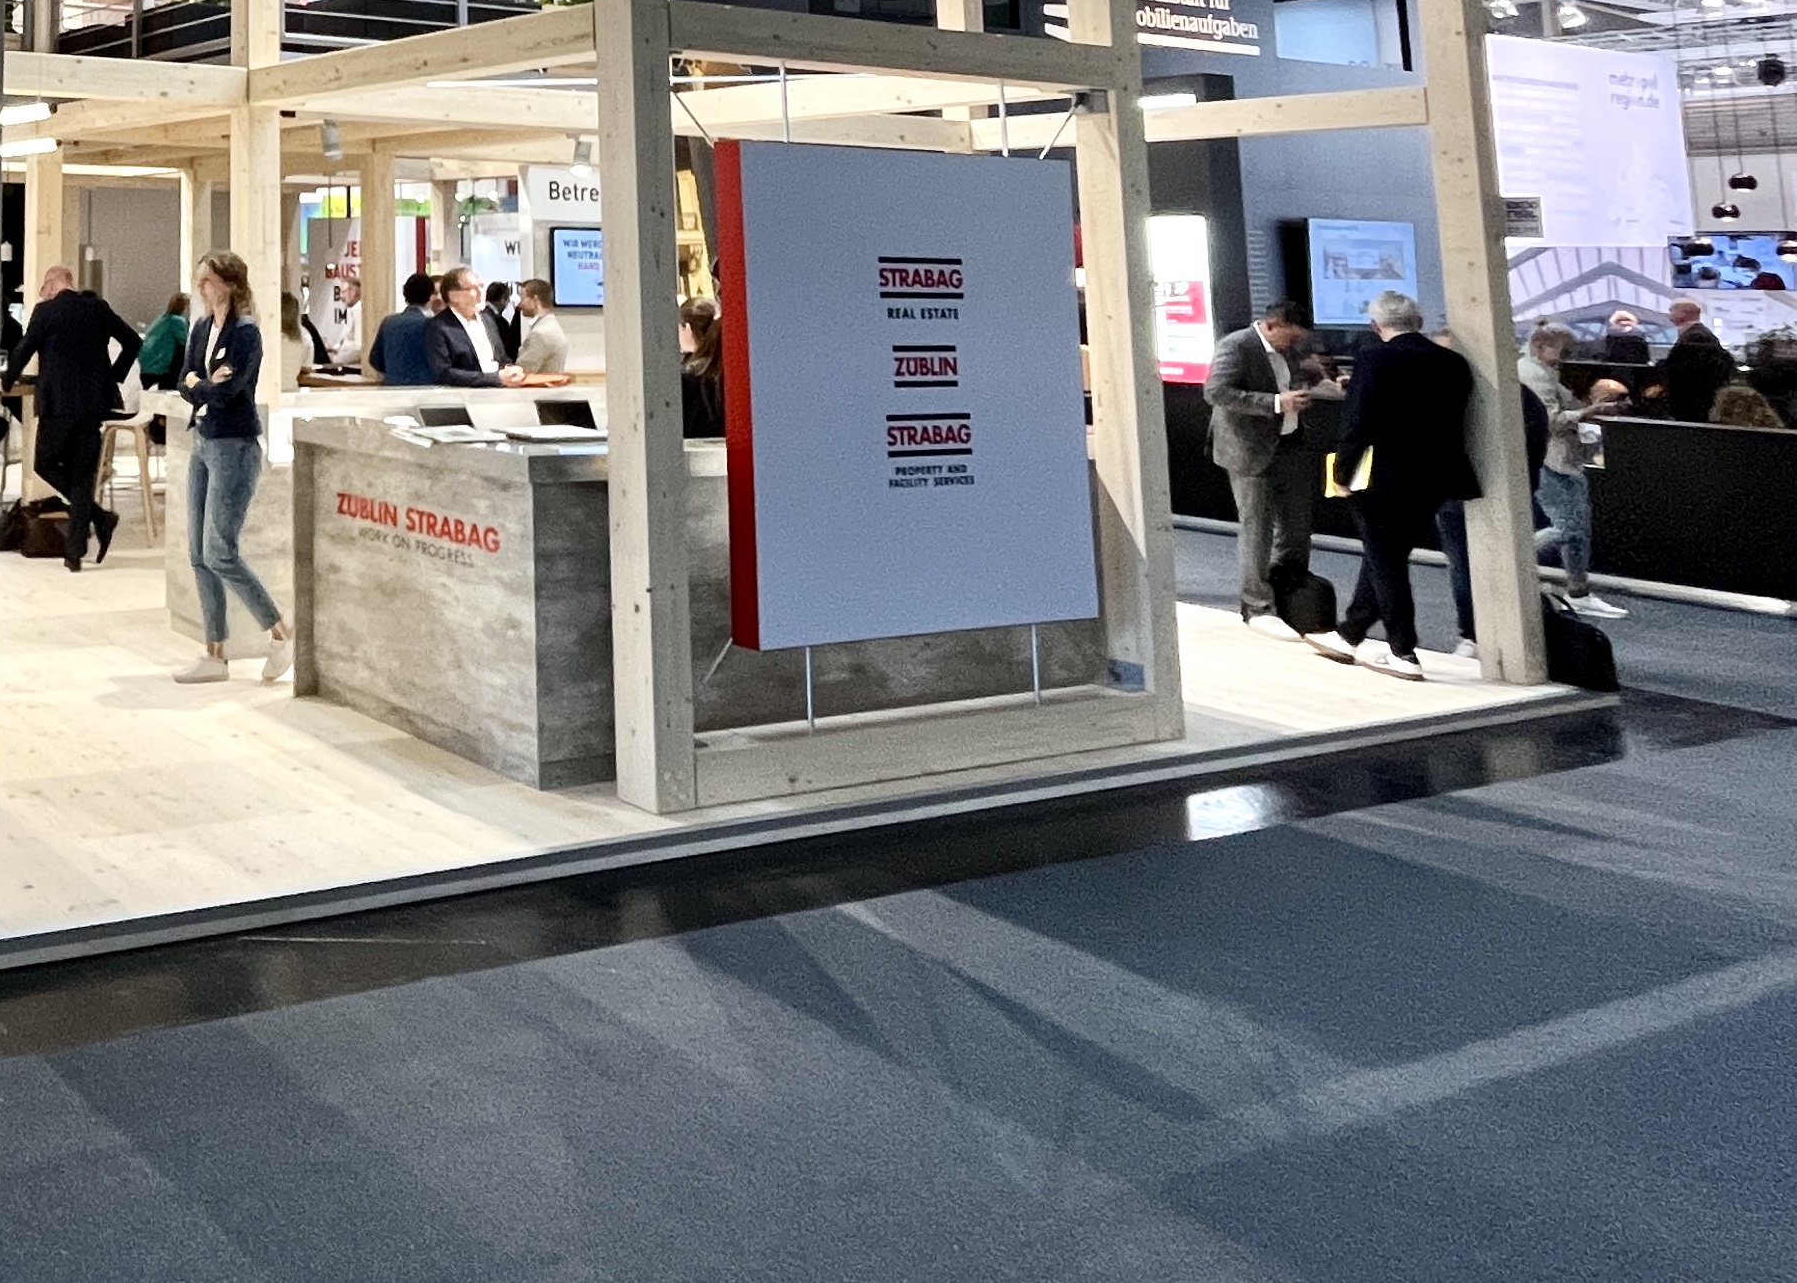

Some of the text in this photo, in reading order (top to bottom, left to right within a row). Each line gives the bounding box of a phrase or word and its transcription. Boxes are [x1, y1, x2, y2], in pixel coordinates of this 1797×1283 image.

[549, 180, 599, 202] Betre
[879, 268, 963, 289] STRABAG
[887, 308, 959, 320] REAL ESTATE
[887, 423, 971, 446] STRABAG
[895, 464, 967, 476] PROPERTY AND
[888, 475, 975, 488] FACILITY SERVICES
[406, 507, 501, 553] STRABAG
[358, 526, 475, 568] WORK ON PROGRESS
